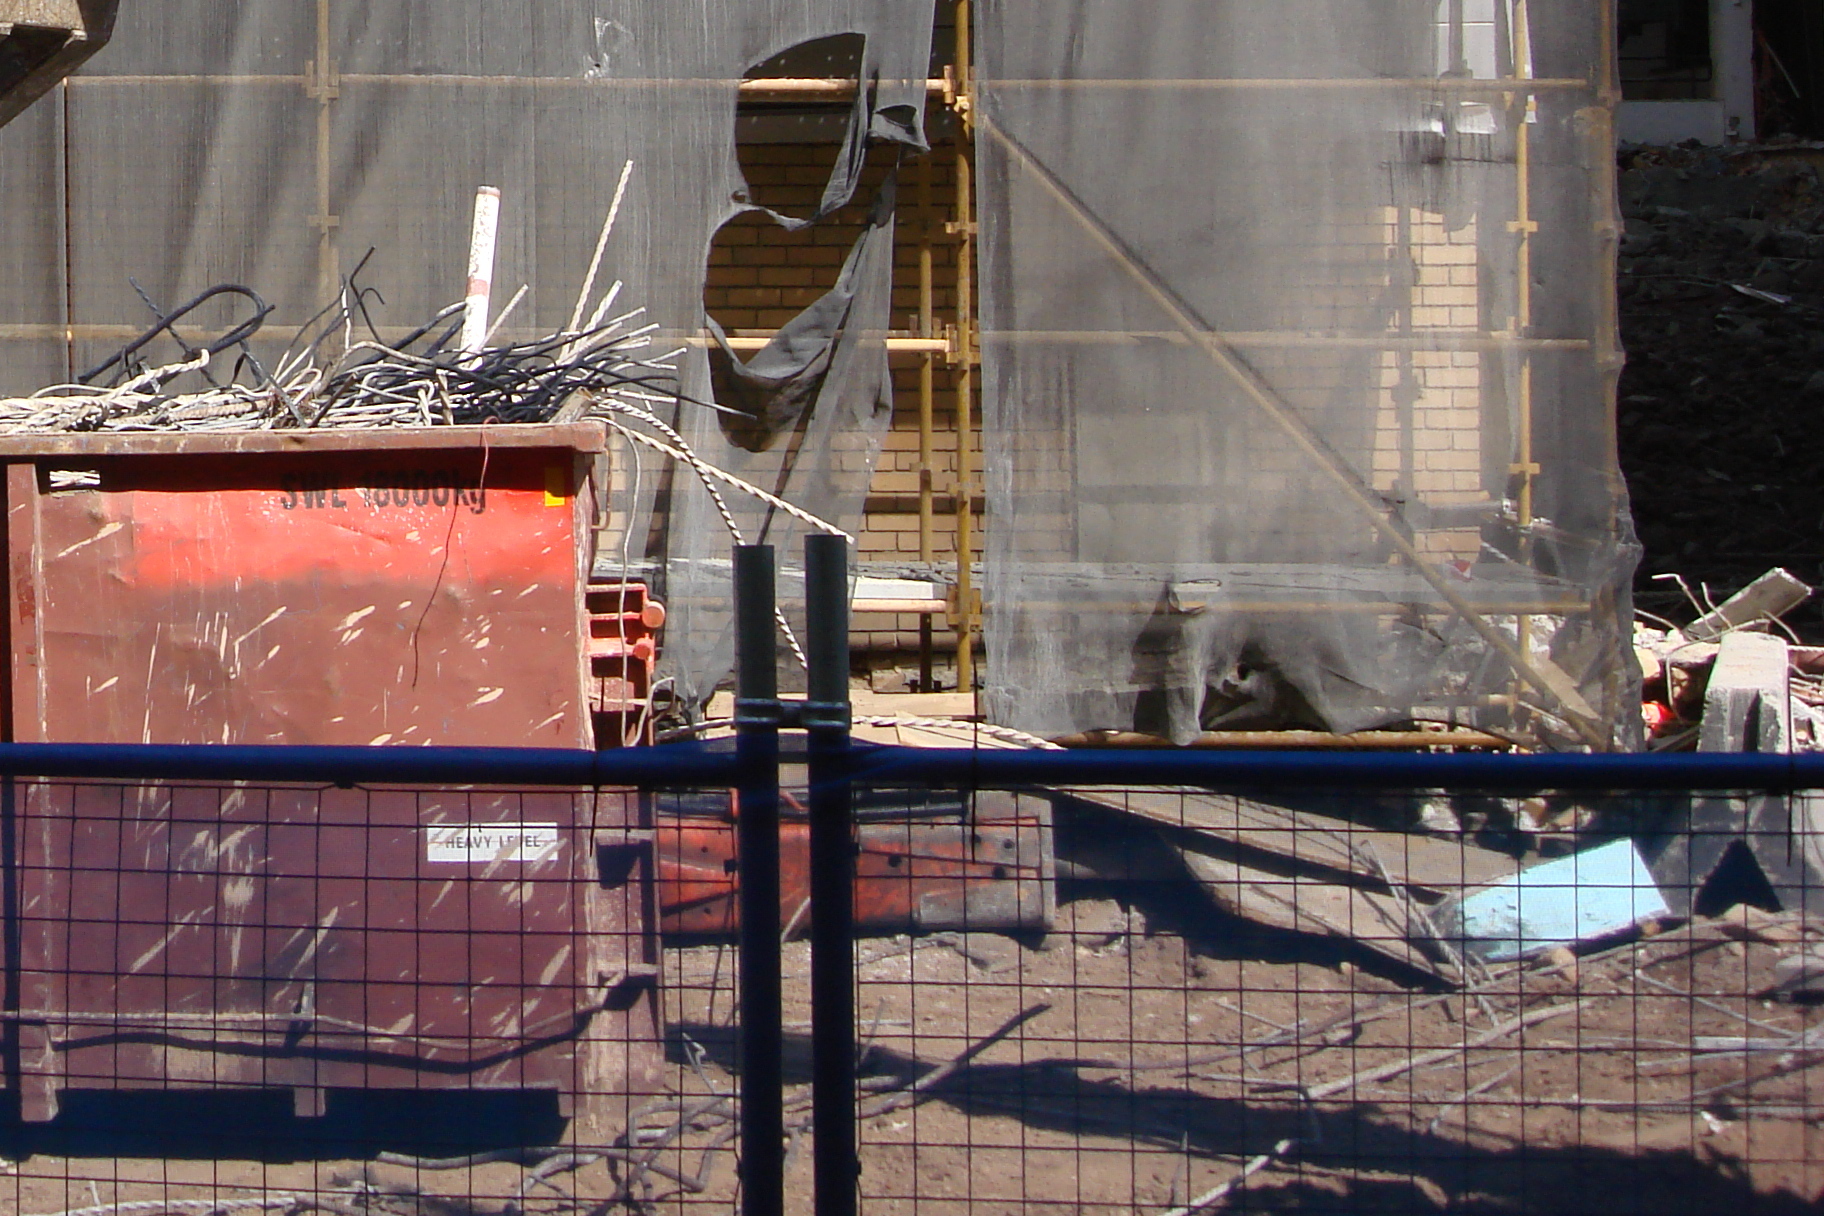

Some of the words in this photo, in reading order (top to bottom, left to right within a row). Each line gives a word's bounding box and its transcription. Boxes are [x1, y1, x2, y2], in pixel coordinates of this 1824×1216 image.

[279, 472, 348, 510] SWL
[445, 835, 492, 849] HEAVY
[498, 834, 541, 848] LEEL
